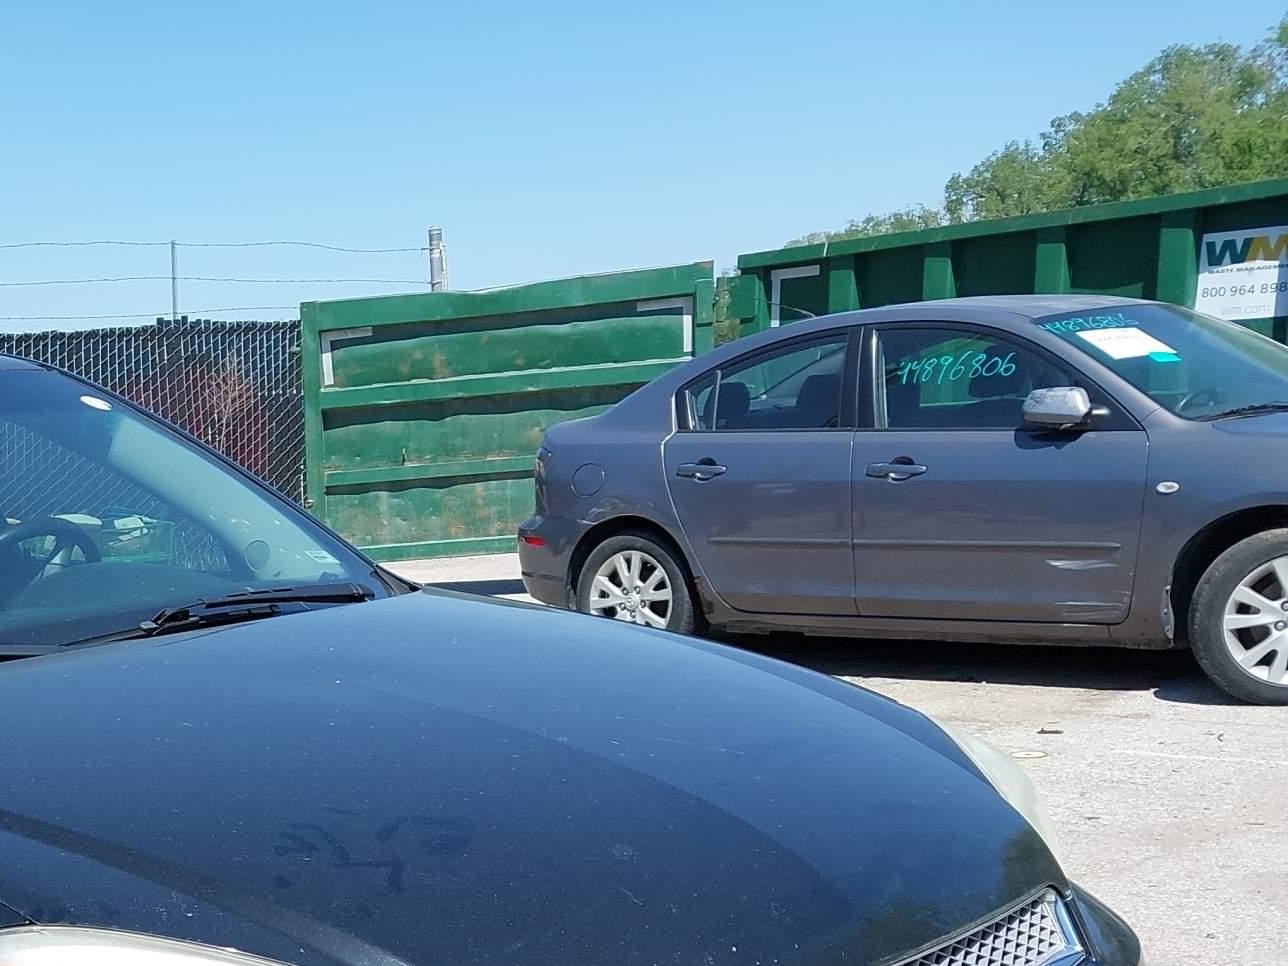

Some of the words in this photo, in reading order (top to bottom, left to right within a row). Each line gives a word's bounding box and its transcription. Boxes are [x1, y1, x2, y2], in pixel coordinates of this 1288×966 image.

[1206, 234, 1288, 267] WM
[1235, 263, 1288, 273] MANAGEME
[1202, 286, 1226, 298] 800
[1230, 284, 1255, 297] 964
[1223, 305, 1272, 315] wm.com
[898, 351, 1016, 384] 44896806
